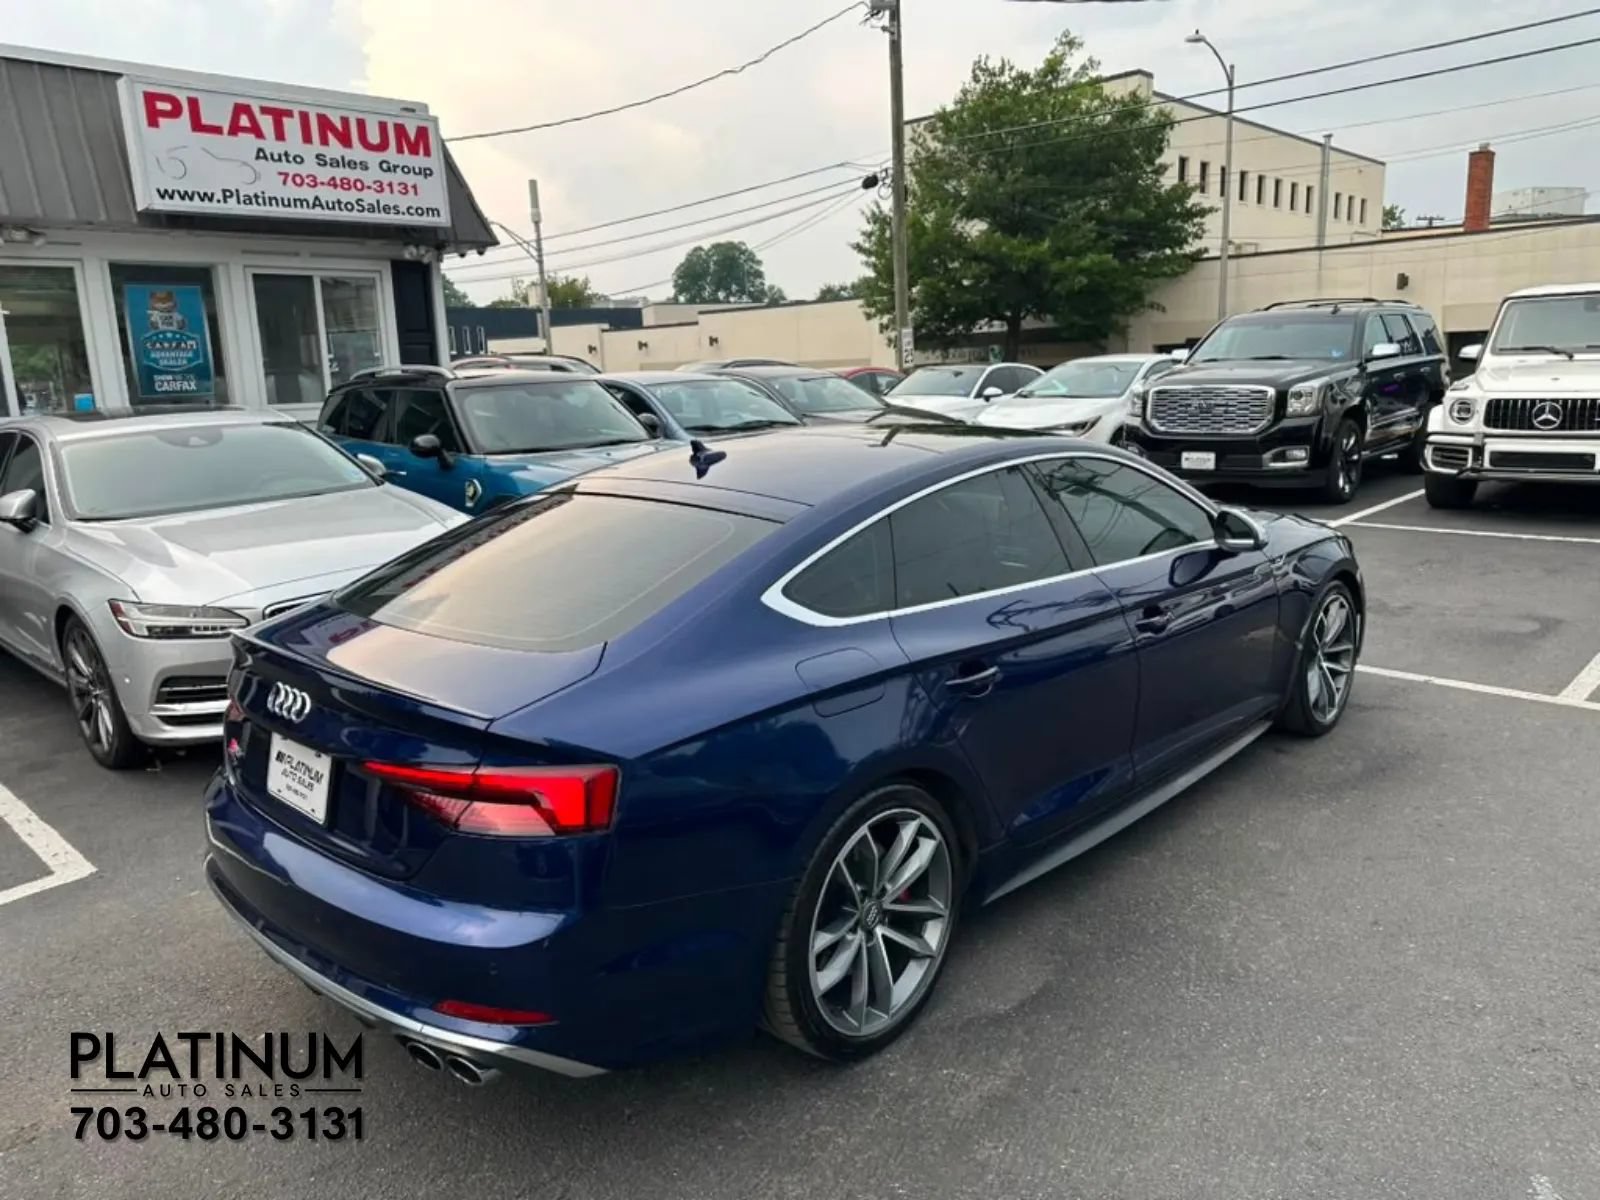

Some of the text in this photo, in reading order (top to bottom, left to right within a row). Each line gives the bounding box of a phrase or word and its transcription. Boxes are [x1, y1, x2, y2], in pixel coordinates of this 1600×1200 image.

[142, 90, 432, 158] PLATINUM
[255, 147, 434, 179] Auto Sales Group
[277, 171, 419, 197] 703-480-3131
[155, 186, 441, 219] www.PlatinumAutoSales.com
[154, 381, 197, 392] CARFAX
